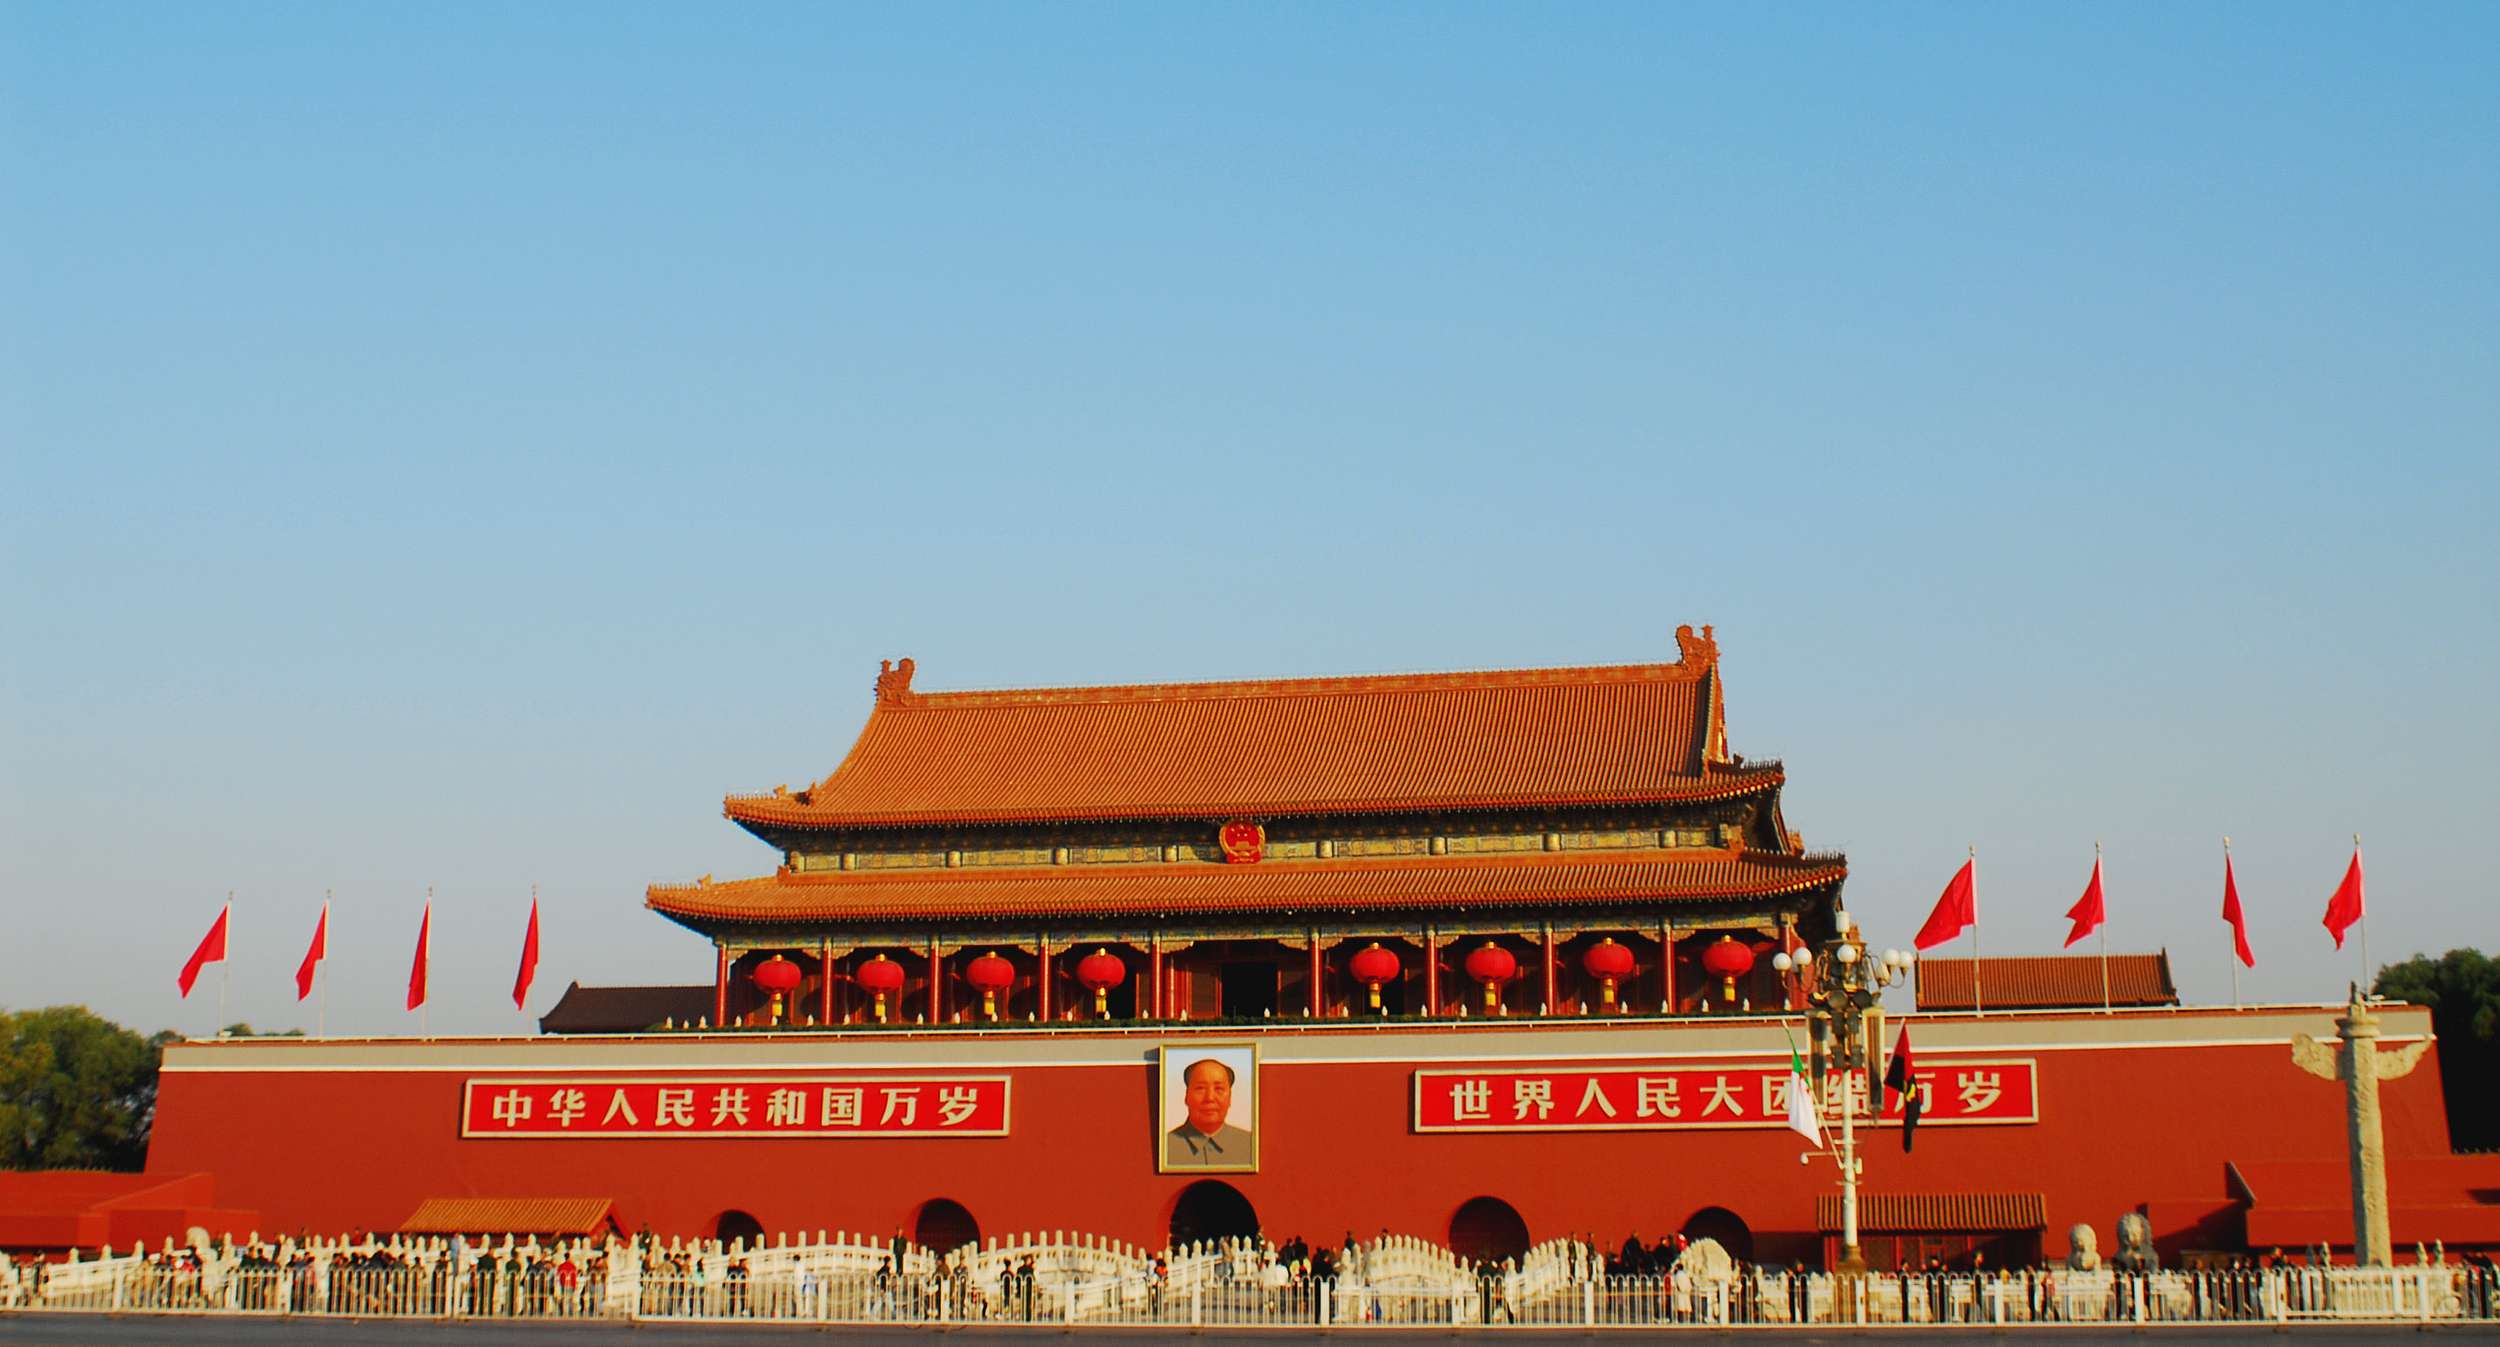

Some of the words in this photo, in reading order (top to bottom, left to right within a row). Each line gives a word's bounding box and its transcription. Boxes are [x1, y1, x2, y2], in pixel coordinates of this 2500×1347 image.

[492, 1086, 979, 1128] 中华人民共和国万岁
